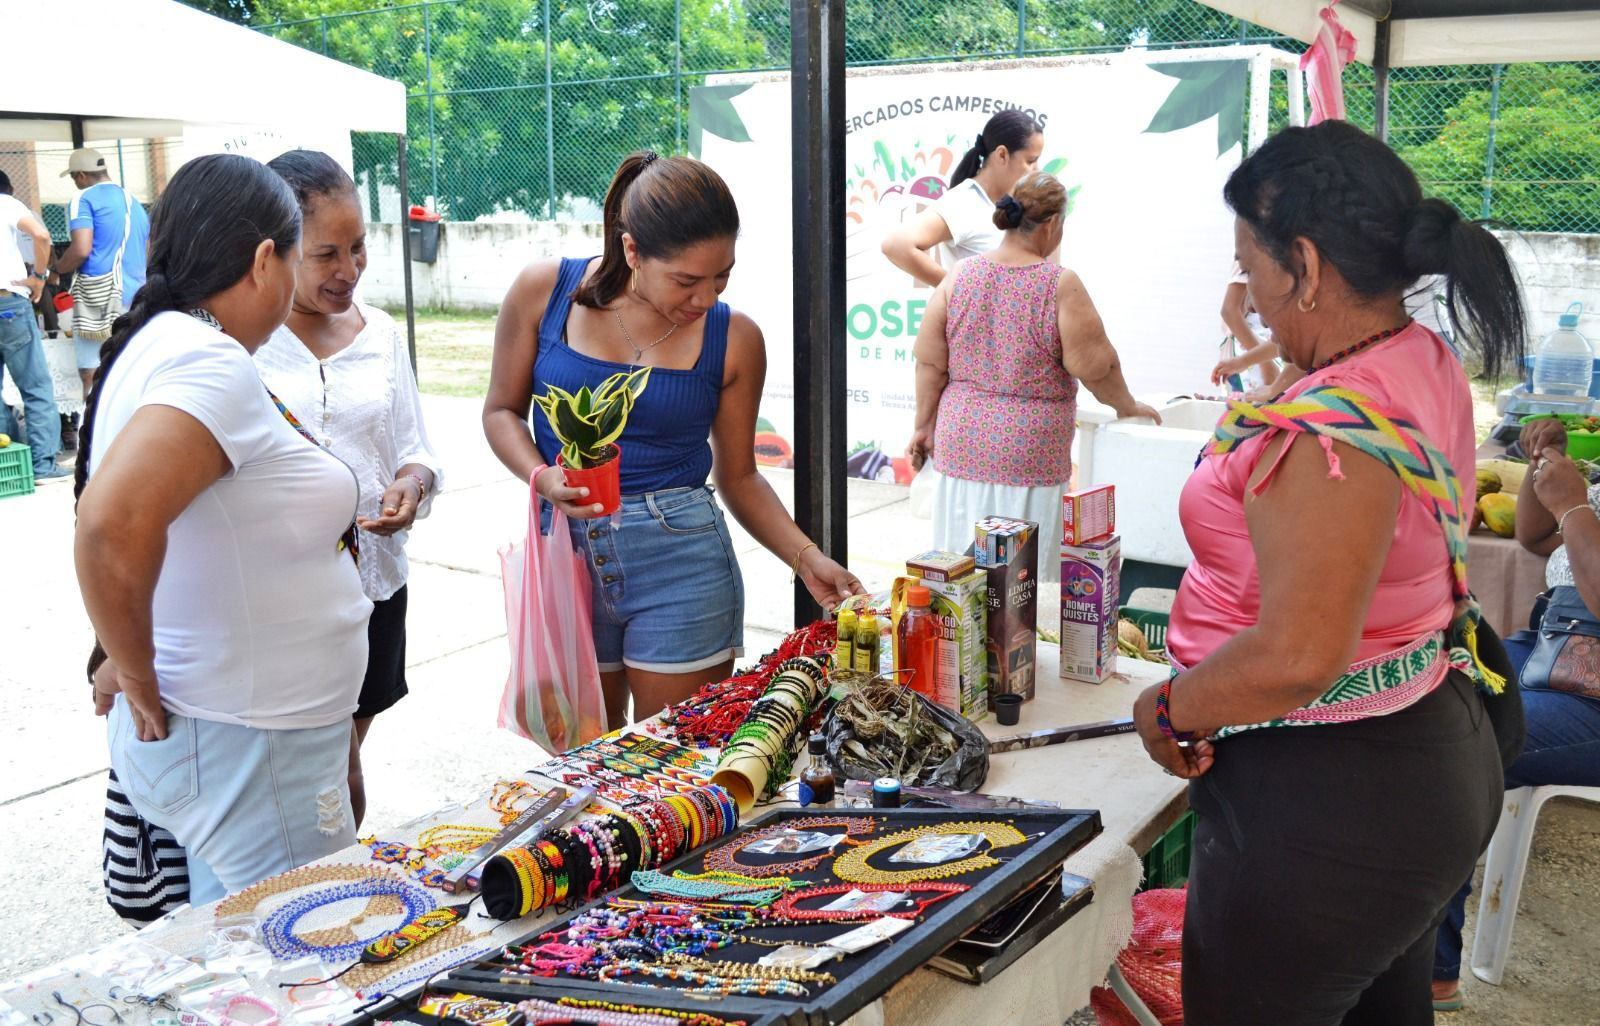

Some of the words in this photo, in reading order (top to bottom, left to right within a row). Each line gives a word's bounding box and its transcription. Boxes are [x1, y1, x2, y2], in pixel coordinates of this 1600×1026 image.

[860, 346, 882, 360] DE
[1008, 579, 1035, 596] LIMPIA
[1012, 591, 1031, 605] CASA
[1066, 600, 1096, 613] ROMPE
[1063, 608, 1099, 622] QUISTES
